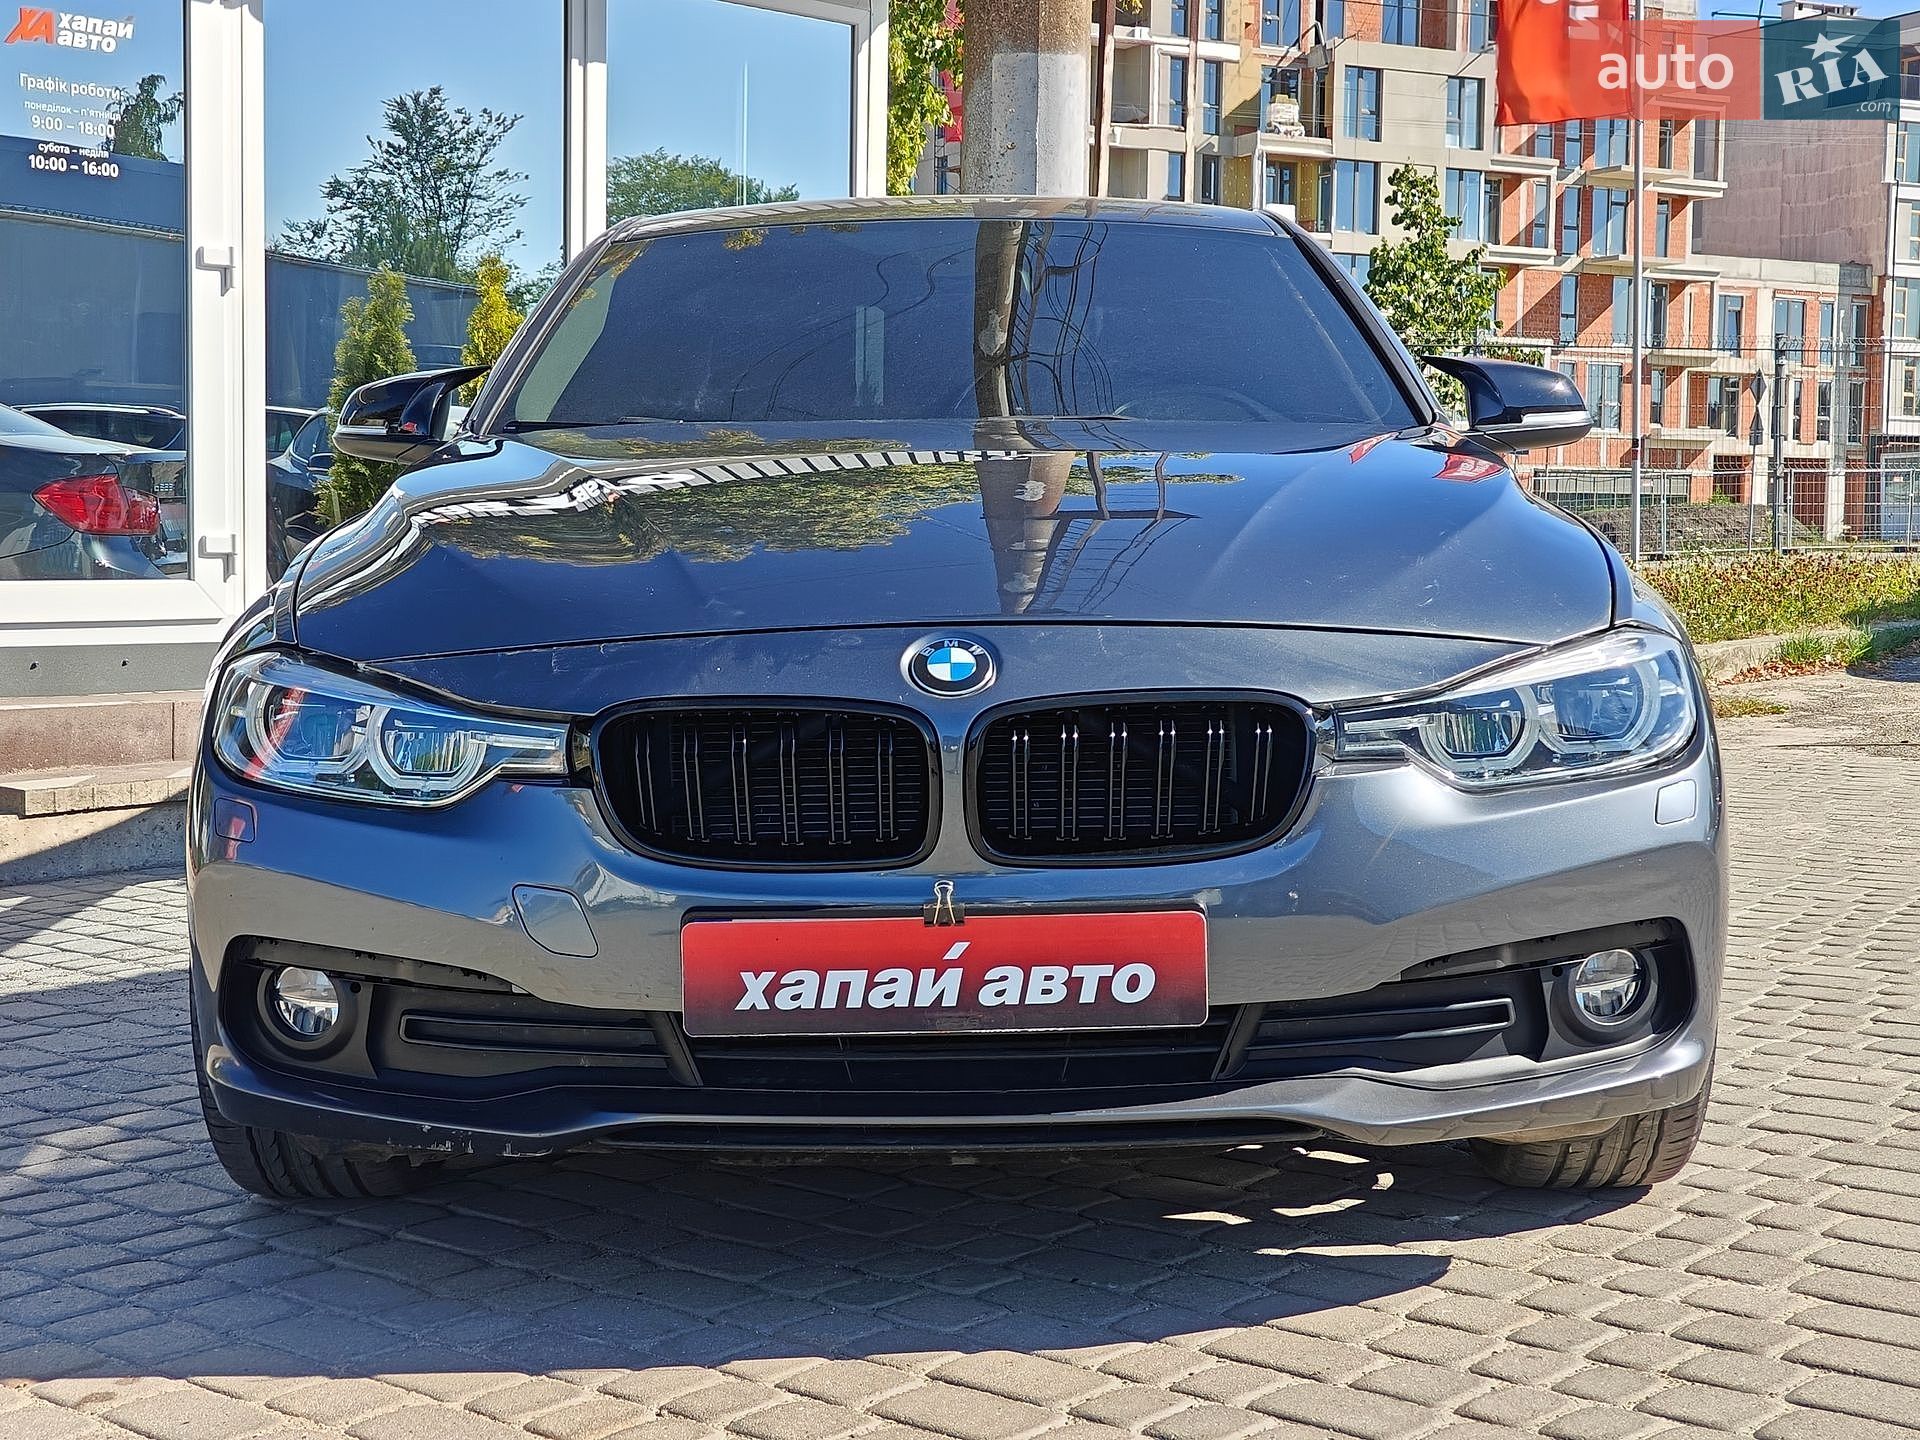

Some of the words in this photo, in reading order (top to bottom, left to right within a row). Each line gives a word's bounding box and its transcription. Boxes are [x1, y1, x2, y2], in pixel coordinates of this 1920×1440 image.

[57, 29, 117, 53] авто
[19, 72, 68, 94] Графік
[24, 100, 72, 115] понеділок
[31, 115, 63, 132] 9:00
[78, 121, 115, 139] 18:00
[38, 142, 71, 154] субота
[79, 147, 109, 159] неділя
[28, 154, 67, 172] 10:00
[82, 160, 119, 178] 16:00
[920, 639, 984, 656] BMW
[734, 941, 971, 1011] хапай
[977, 962, 1156, 1007] авто
